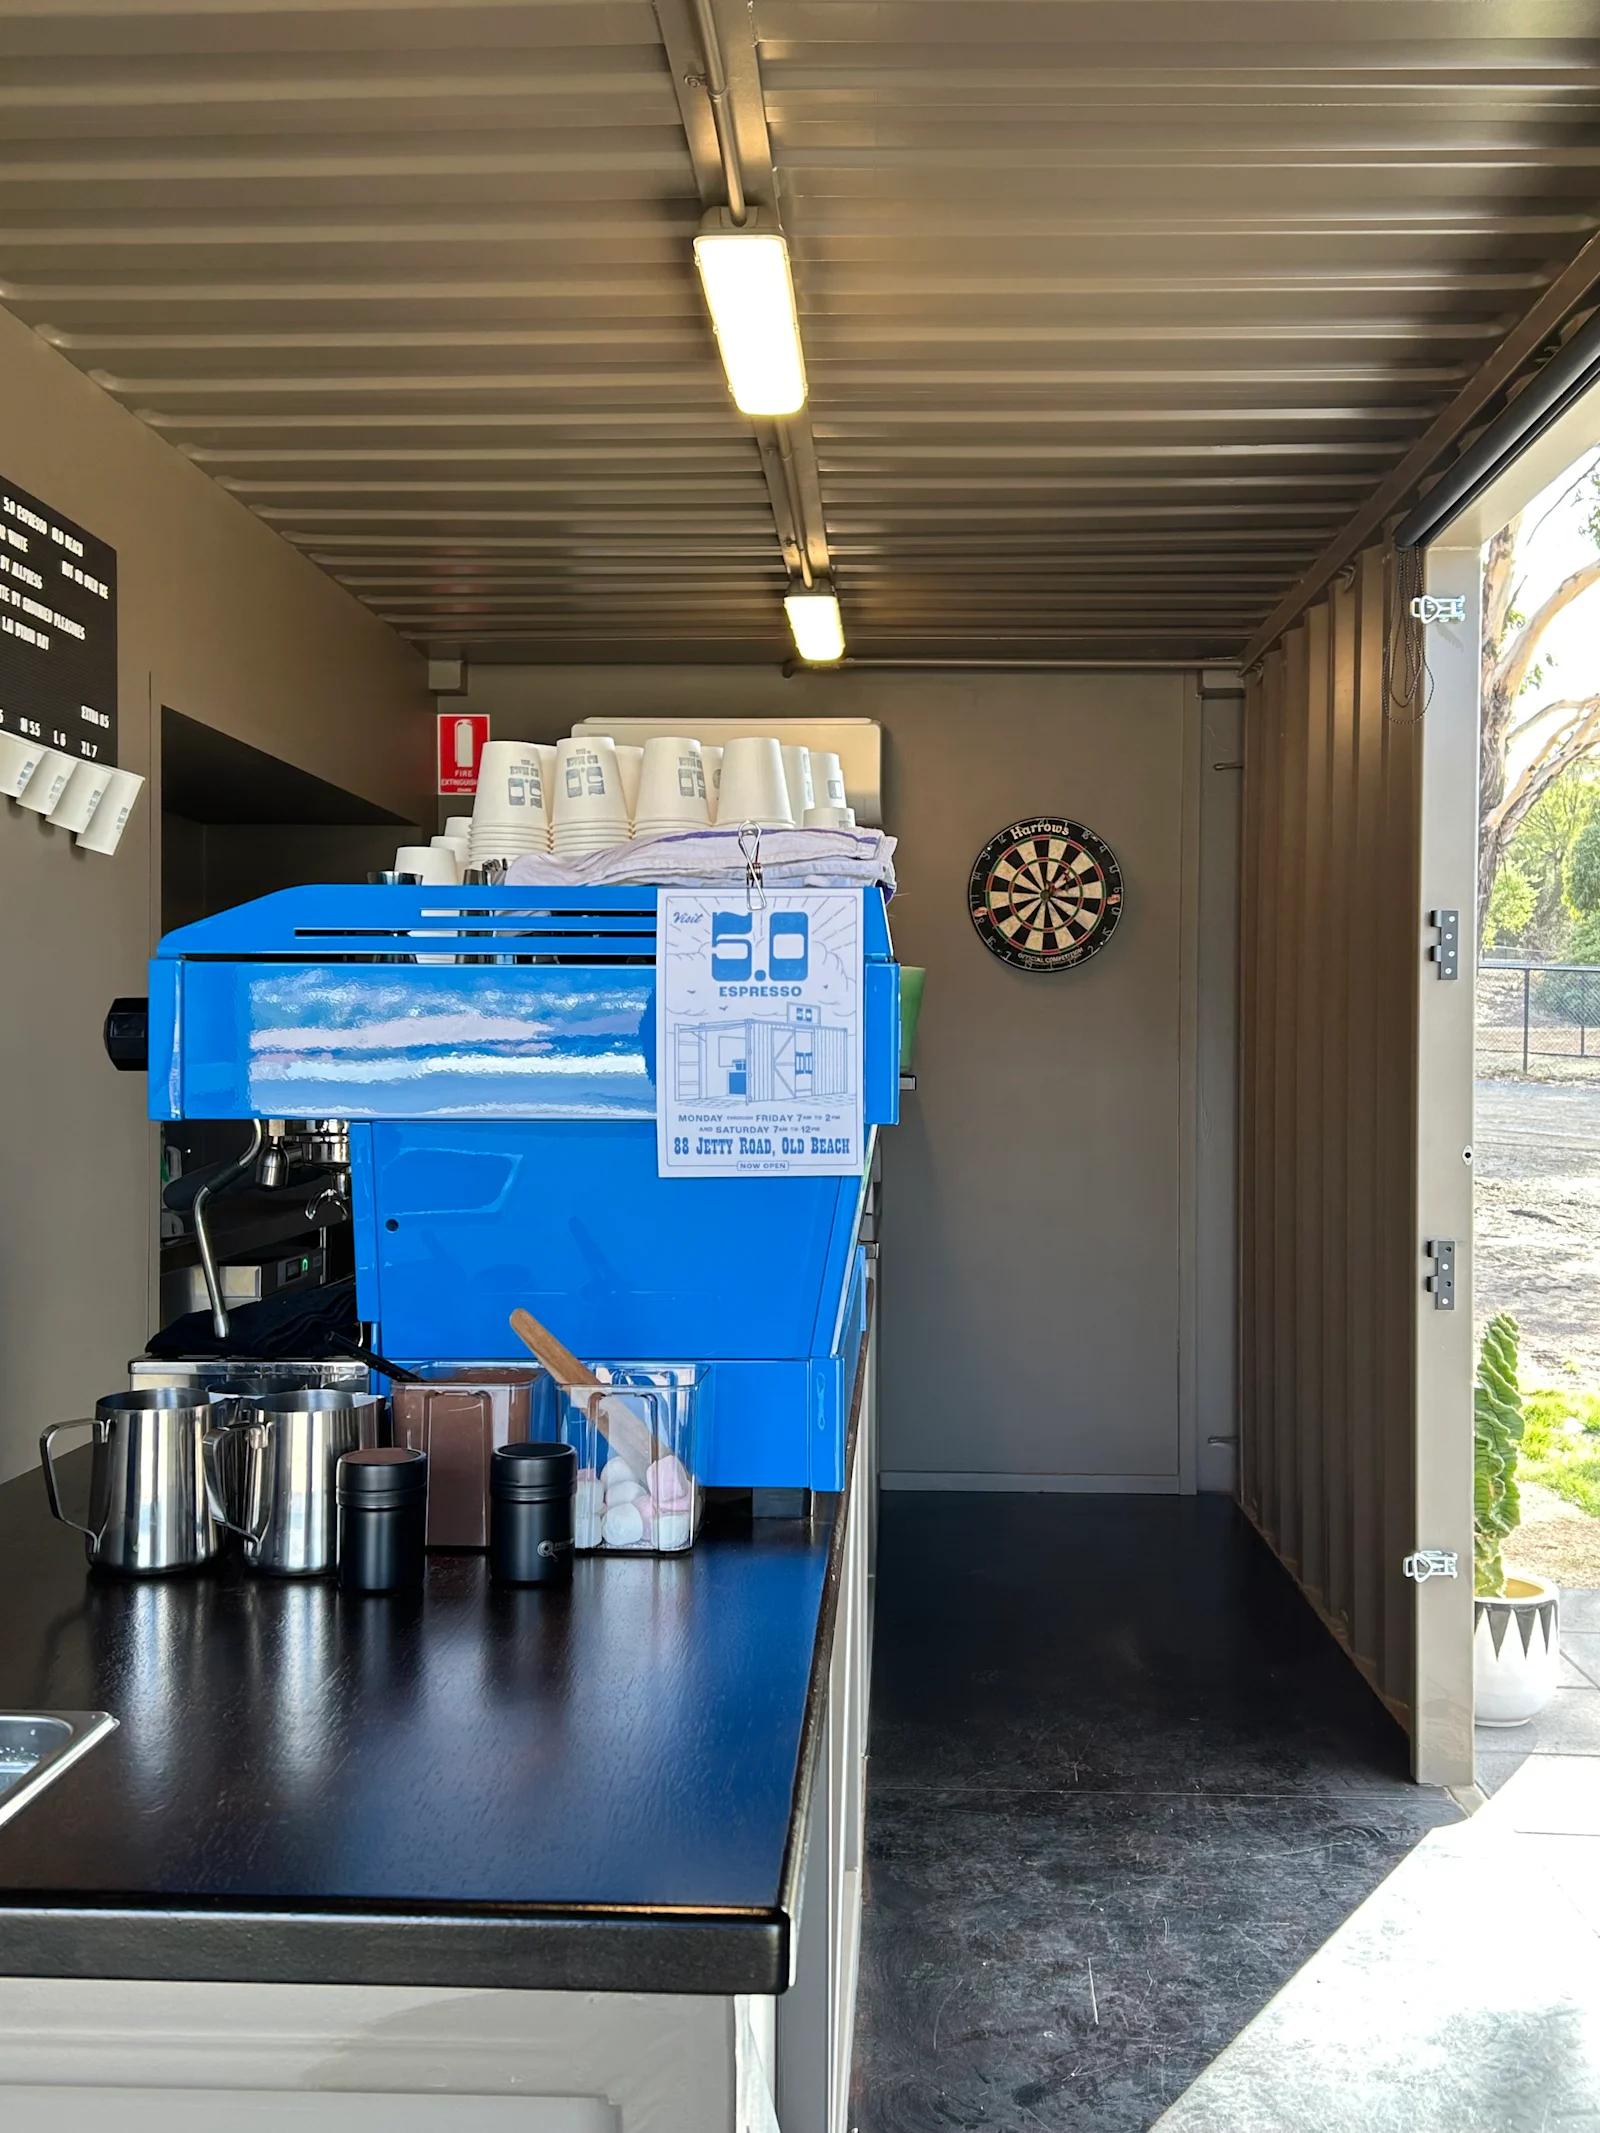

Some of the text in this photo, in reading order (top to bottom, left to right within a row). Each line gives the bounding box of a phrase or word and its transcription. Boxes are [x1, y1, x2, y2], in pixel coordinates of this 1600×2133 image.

[17, 505, 48, 535] ESPRESSO
[11, 561, 43, 590] ALLPRESS
[53, 730, 59, 745] L
[60, 733, 67, 747] 6
[441, 778, 478, 786] EXTINGUISH
[455, 770, 474, 778] FIRE
[1010, 823, 1069, 840] Harrows
[673, 911, 704, 924] Visit
[711, 911, 809, 982] 5.0
[1045, 946, 1084, 962] COMPETITION
[719, 986, 802, 997] ESPRESSO
[678, 1114, 723, 1122] MONDAY
[755, 1114, 793, 1122] FRIDAY
[715, 1126, 769, 1134] SATURDAY
[674, 1137, 689, 1155] 88
[696, 1137, 733, 1155] JETTY
[781, 1137, 805, 1154] OLD
[811, 1137, 850, 1154] BEACH
